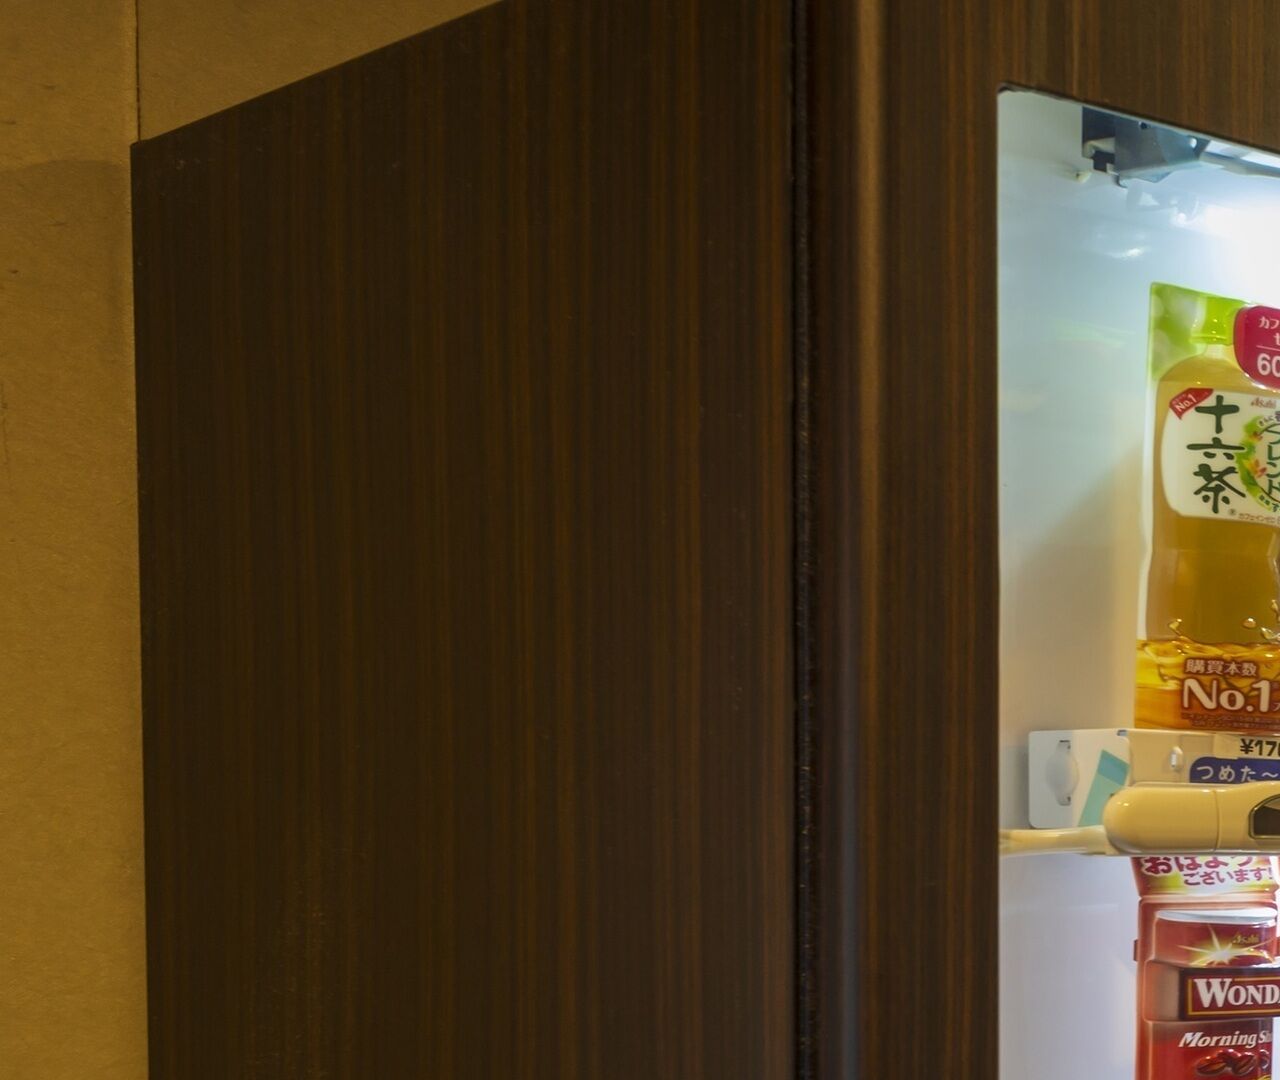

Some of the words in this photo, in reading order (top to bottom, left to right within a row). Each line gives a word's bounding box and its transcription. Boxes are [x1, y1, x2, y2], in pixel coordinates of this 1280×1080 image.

[1187, 395, 1246, 513] 十六茶
[1186, 658, 1257, 677] 購買本数
[1183, 678, 1271, 713] No.1
[1179, 1032, 1257, 1048] Morning
